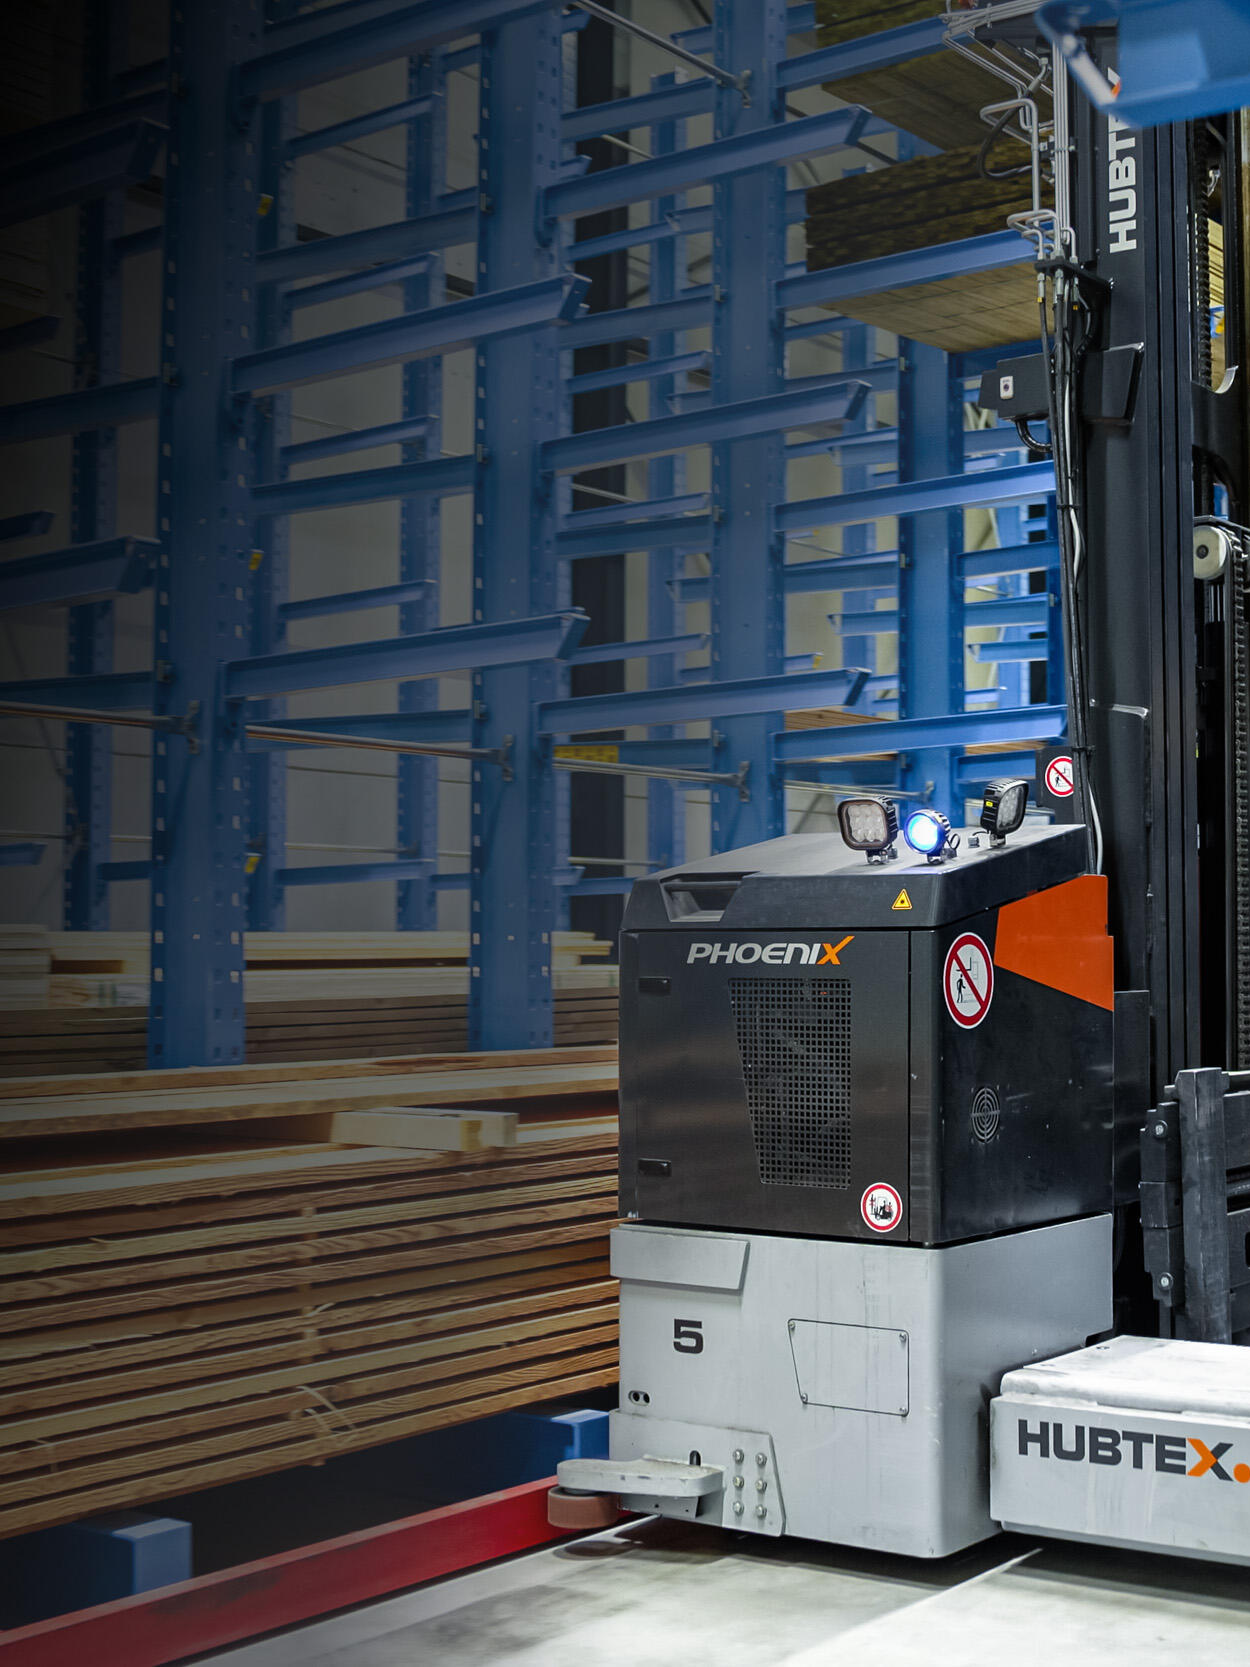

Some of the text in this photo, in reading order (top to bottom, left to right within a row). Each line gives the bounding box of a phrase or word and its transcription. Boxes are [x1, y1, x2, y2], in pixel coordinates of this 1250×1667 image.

[1108, 66, 1137, 254] HUBT
[687, 935, 855, 965] PHOENIX
[673, 1319, 704, 1354] 5
